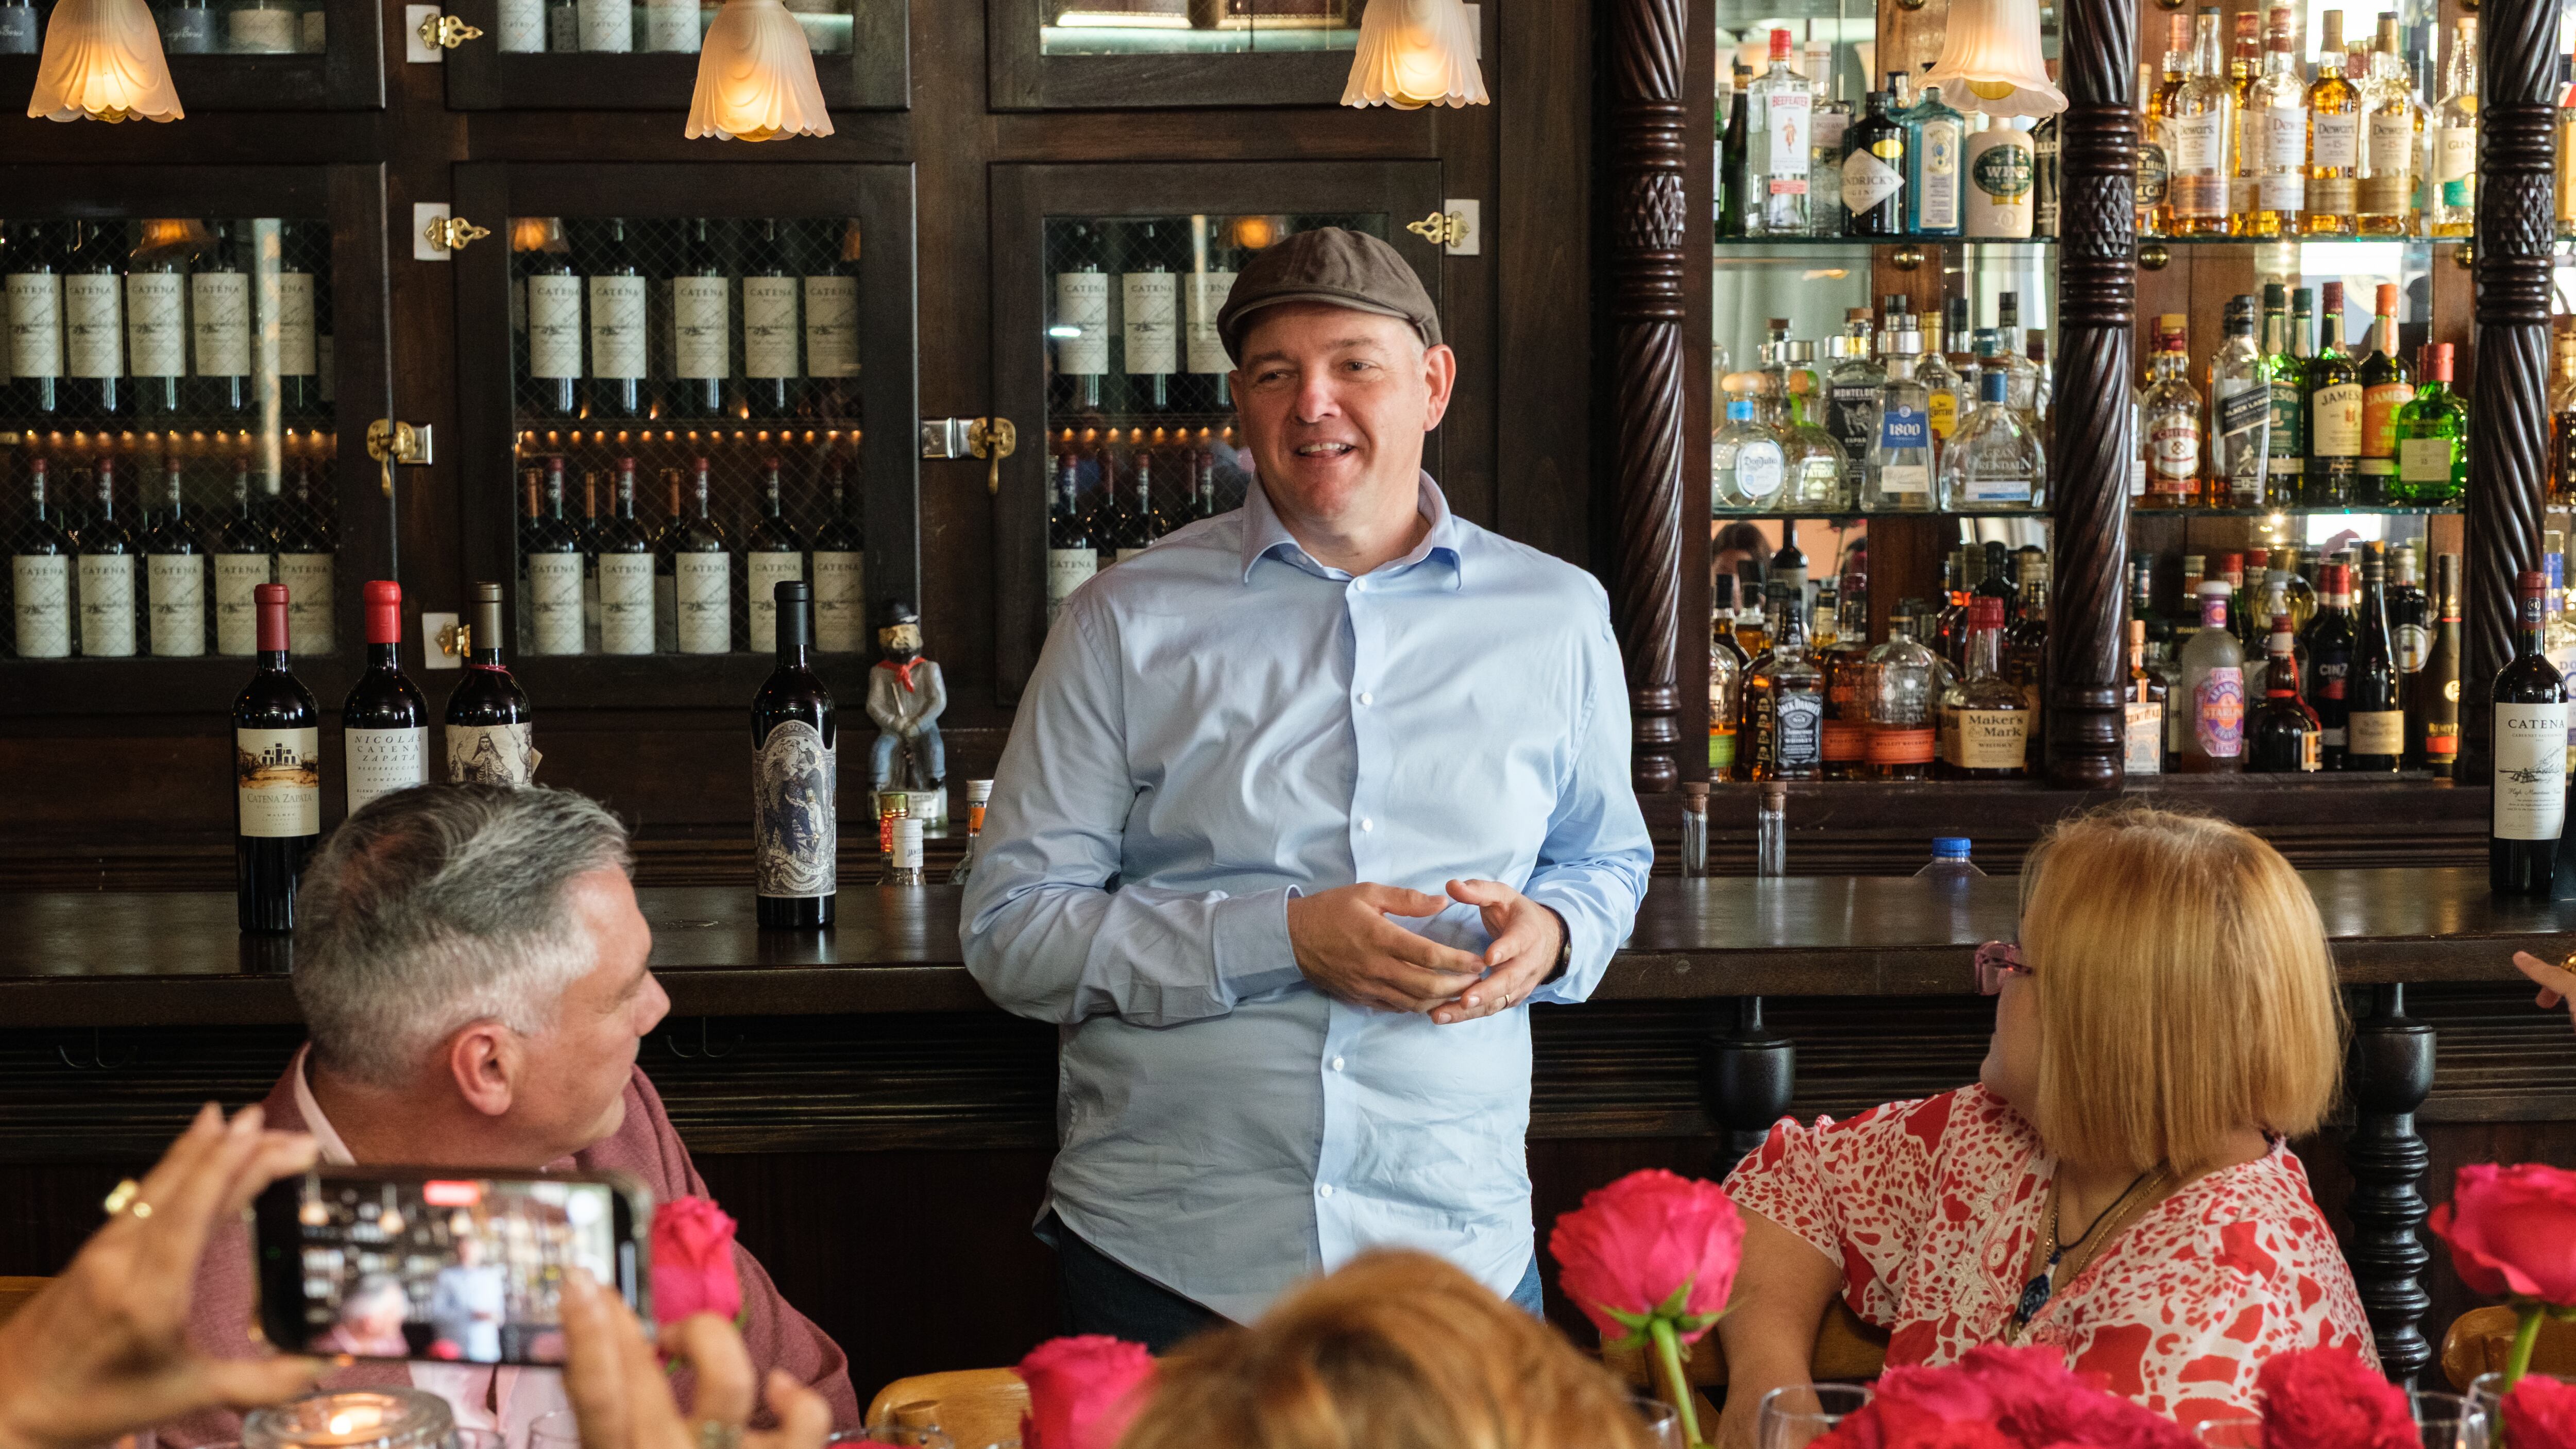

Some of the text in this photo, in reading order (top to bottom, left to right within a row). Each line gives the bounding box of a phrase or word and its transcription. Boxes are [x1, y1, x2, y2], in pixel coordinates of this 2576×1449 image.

[1773, 96, 1808, 108] BEEFEATER
[2321, 389, 2362, 406] JAMES
[1889, 423, 1921, 436] 1800
[1969, 715, 2024, 725] Maker's
[2508, 719, 2565, 729] CATENA
[1985, 727, 2022, 737] Mark
[354, 734, 421, 744] NICOLÁS
[247, 793, 312, 803] CATENA ZAPATA
